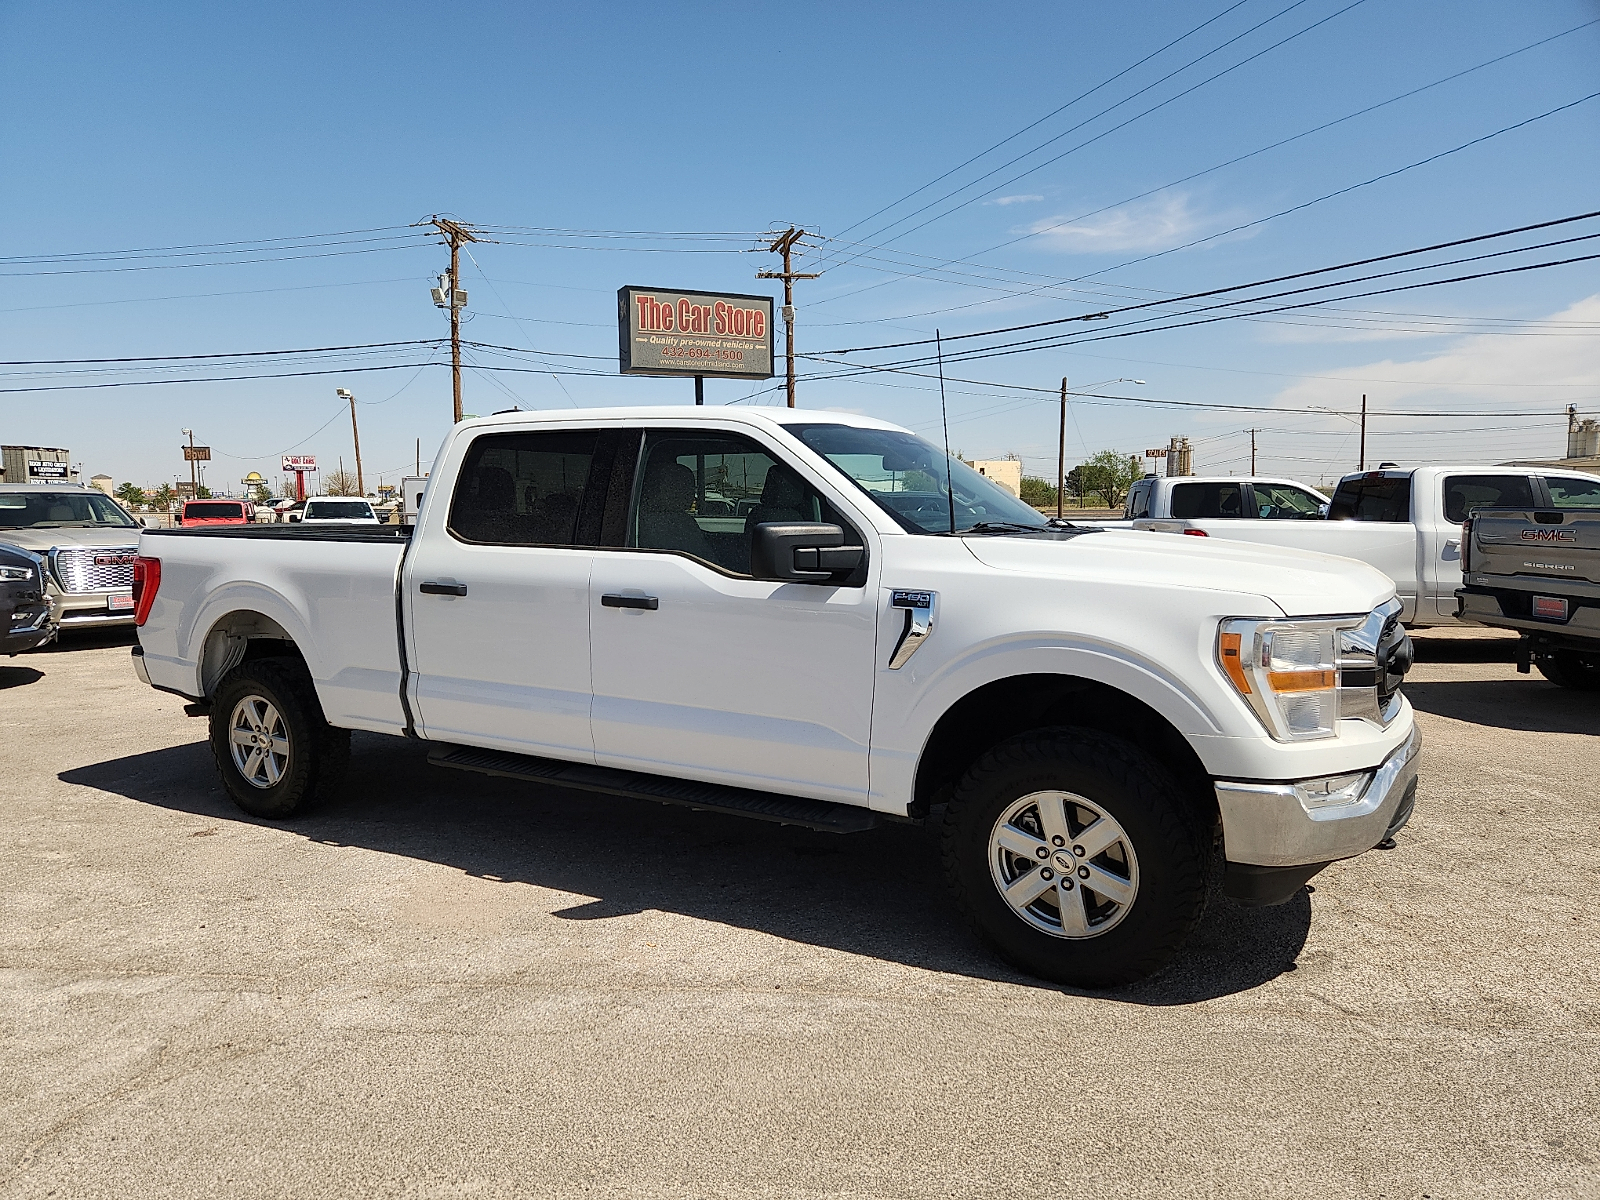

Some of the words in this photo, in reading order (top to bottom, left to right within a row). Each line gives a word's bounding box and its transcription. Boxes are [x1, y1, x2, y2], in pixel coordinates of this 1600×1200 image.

[635, 295, 674, 332] The
[676, 298, 712, 334] Car
[714, 300, 766, 338] Store
[649, 335, 679, 347] Quality
[679, 339, 721, 349] pre-owned
[722, 341, 754, 350] vehicles
[661, 346, 743, 361] 432-694-1500
[185, 449, 210, 460] Bowl
[1521, 528, 1577, 543] GMC
[1523, 562, 1576, 570] SIERRA
[894, 592, 930, 602] F-150
